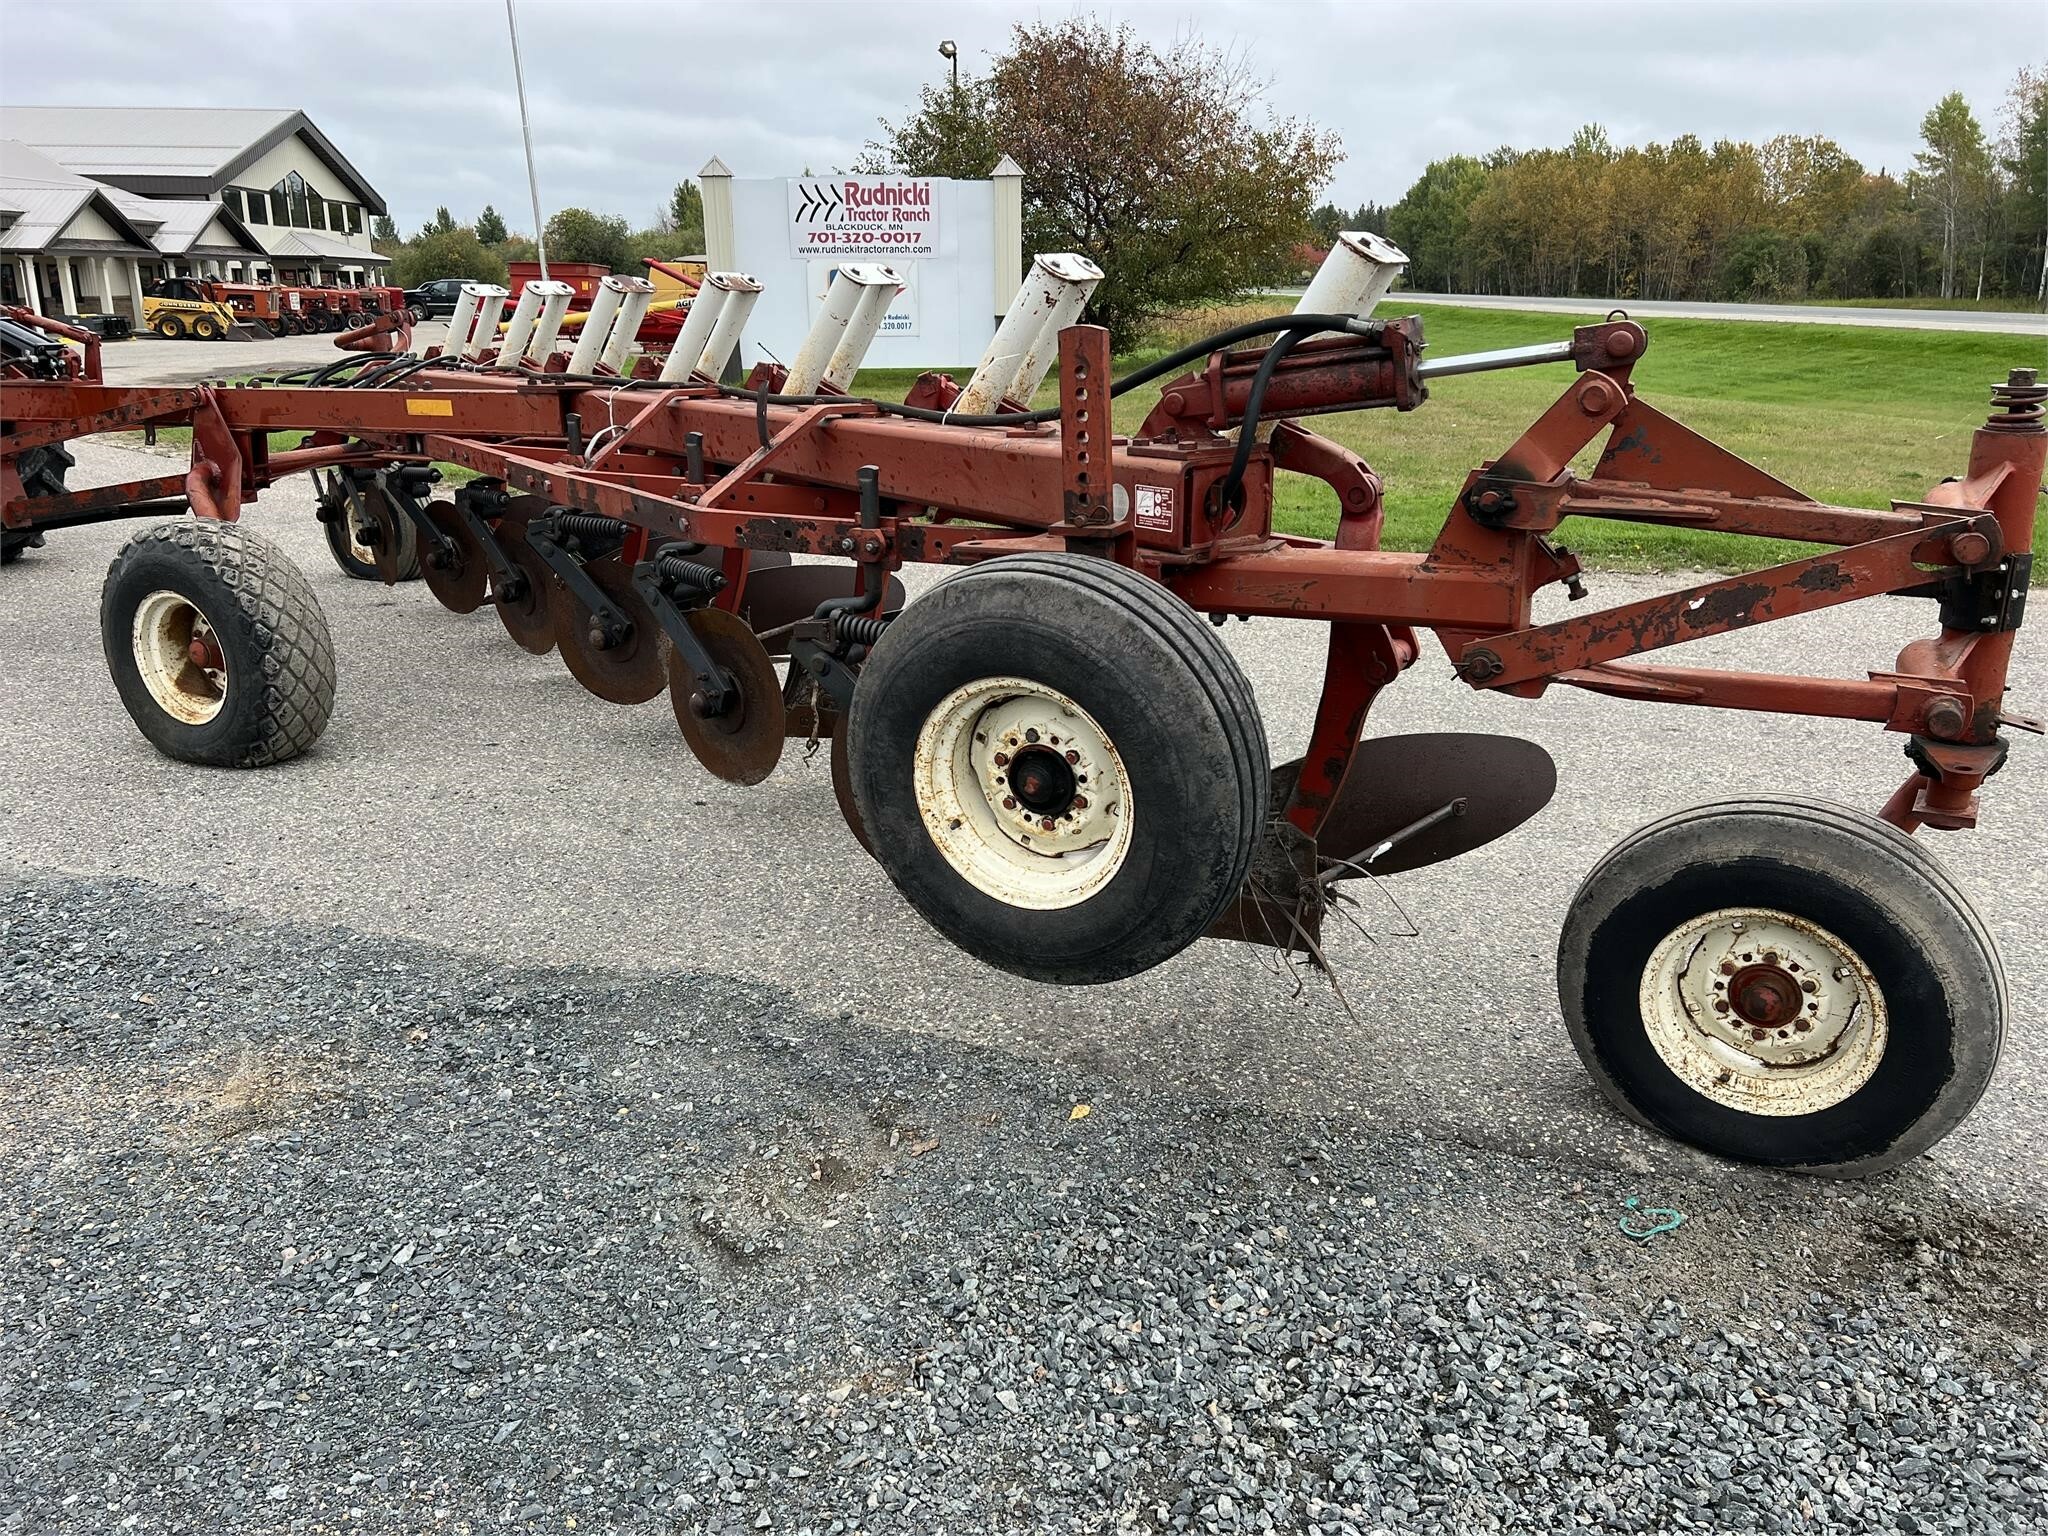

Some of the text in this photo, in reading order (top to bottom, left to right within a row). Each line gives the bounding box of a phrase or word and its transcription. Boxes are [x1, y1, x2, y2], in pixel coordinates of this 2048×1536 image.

[844, 182, 930, 208] Rudnicki
[845, 207, 930, 223] Tractor Ranch
[888, 223, 903, 231] MN
[807, 232, 922, 244] 701-320-0017
[798, 244, 932, 254] www.rudnickitractorranch.com
